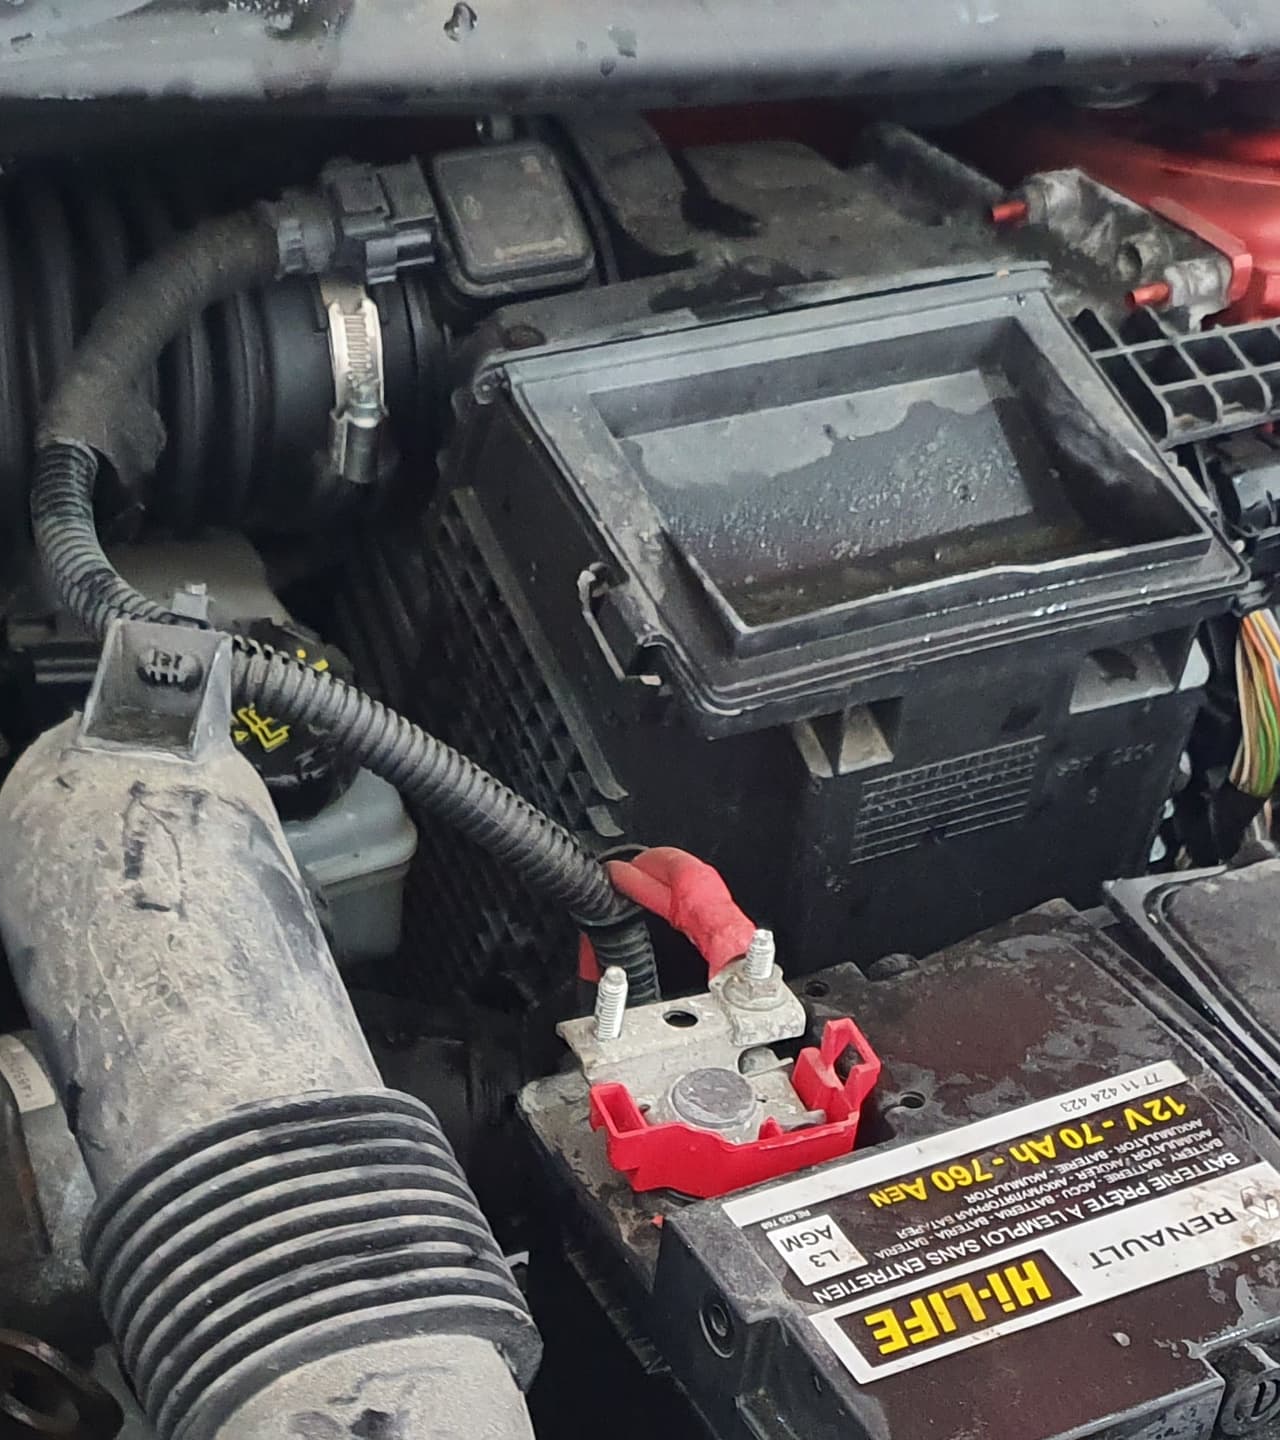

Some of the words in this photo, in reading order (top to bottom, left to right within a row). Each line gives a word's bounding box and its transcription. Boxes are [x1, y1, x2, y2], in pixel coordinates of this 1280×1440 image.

[1119, 1079, 1140, 1092] 11
[1142, 1071, 1163, 1086] 77
[1058, 1096, 1088, 1113] 423
[1089, 1086, 1118, 1103] 424
[1008, 1133, 1057, 1164] Ah
[1058, 1122, 1104, 1149] 70
[1053, 1149, 1109, 1175] BATERIE
[1168, 1136, 1224, 1163] BATTERY
[930, 1158, 993, 1192] 760
[1101, 1157, 1164, 1184] BATTERIE
[1146, 1150, 1241, 1191] BATTERIE
[962, 1168, 1048, 1204] AKUMULATOR
[1060, 1178, 1097, 1199] ACCU
[1081, 1180, 1151, 1213] PRÊTE
[993, 1193, 1056, 1220] BATTERIA
[1063, 1202, 1085, 1220] À
[778, 1223, 833, 1253] AGM
[924, 1238, 981, 1265] SANS
[1088, 1206, 1238, 1270] RENAULT
[807, 1248, 841, 1268] L3
[811, 1255, 927, 1304] ENTRETIEN
[863, 1259, 1052, 1354] Hi-LIFE
